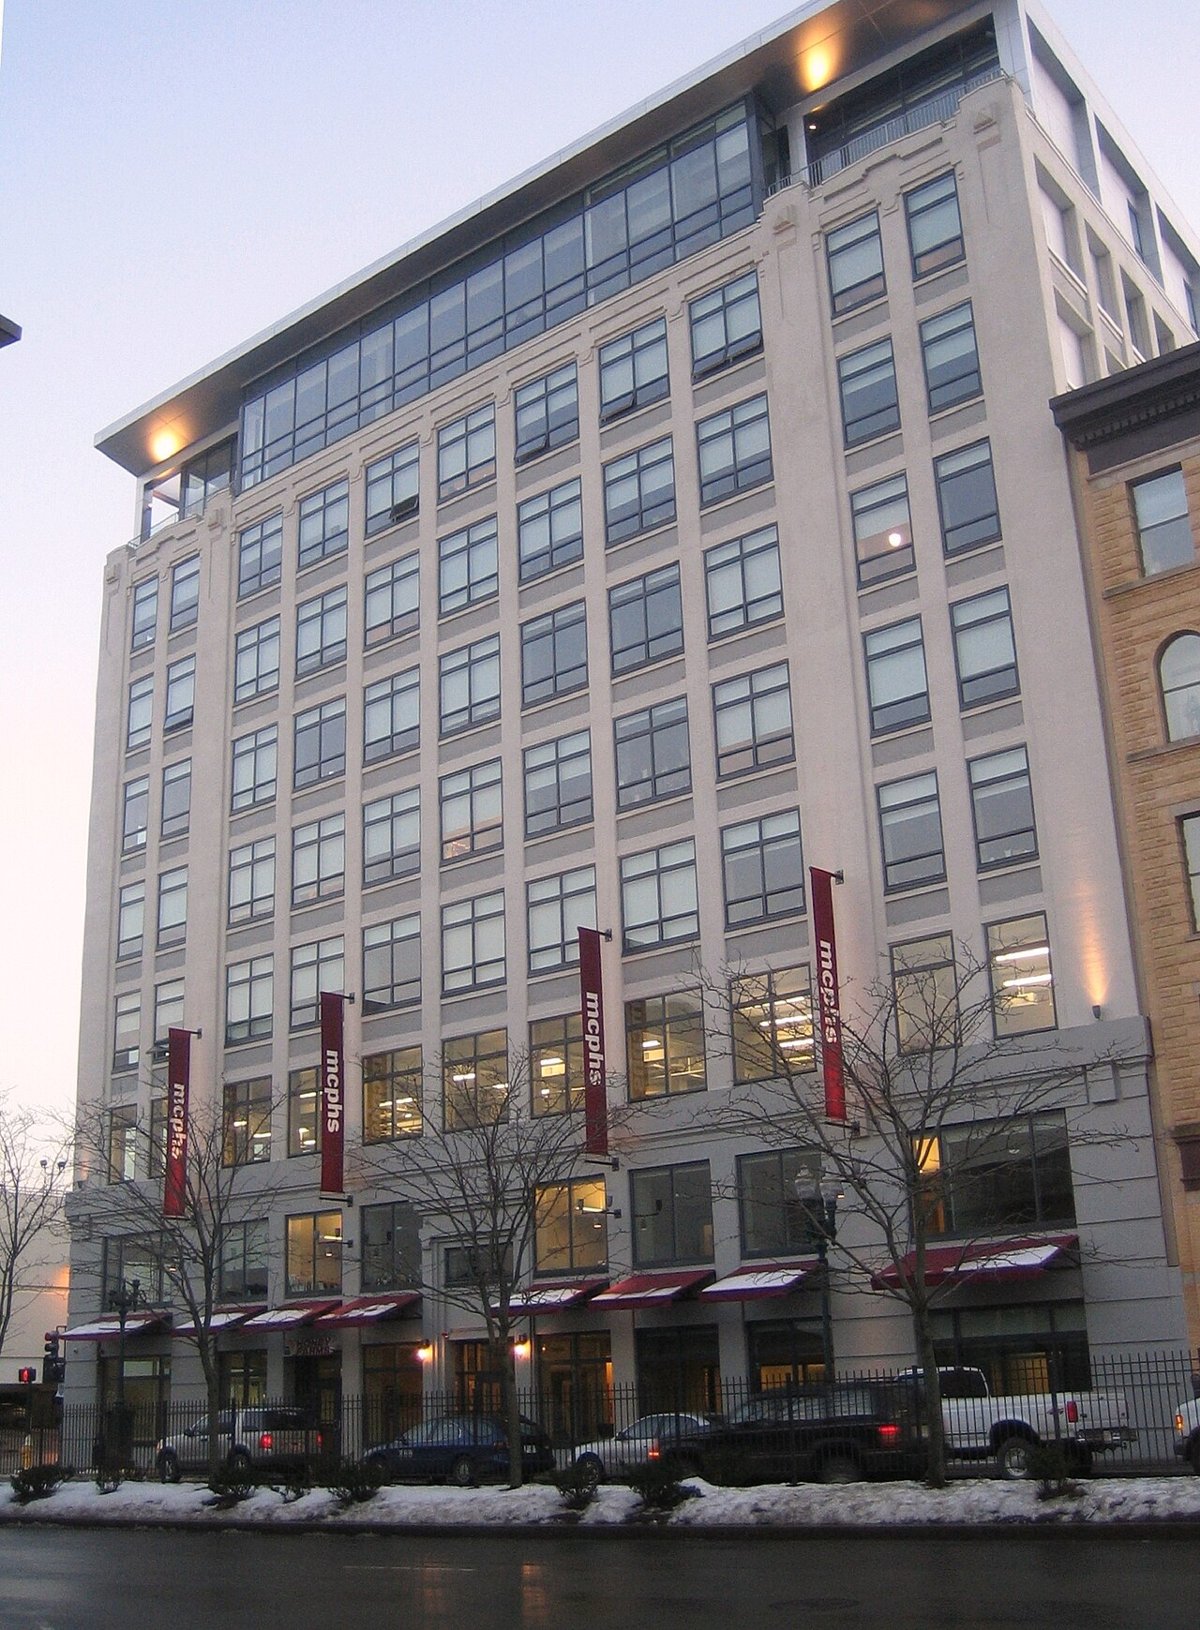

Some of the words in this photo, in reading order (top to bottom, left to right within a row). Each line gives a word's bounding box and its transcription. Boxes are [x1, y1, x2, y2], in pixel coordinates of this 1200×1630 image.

[585, 992, 604, 1087] mcphs
[819, 940, 840, 1044] mcphs
[325, 1050, 343, 1134] mcphs
